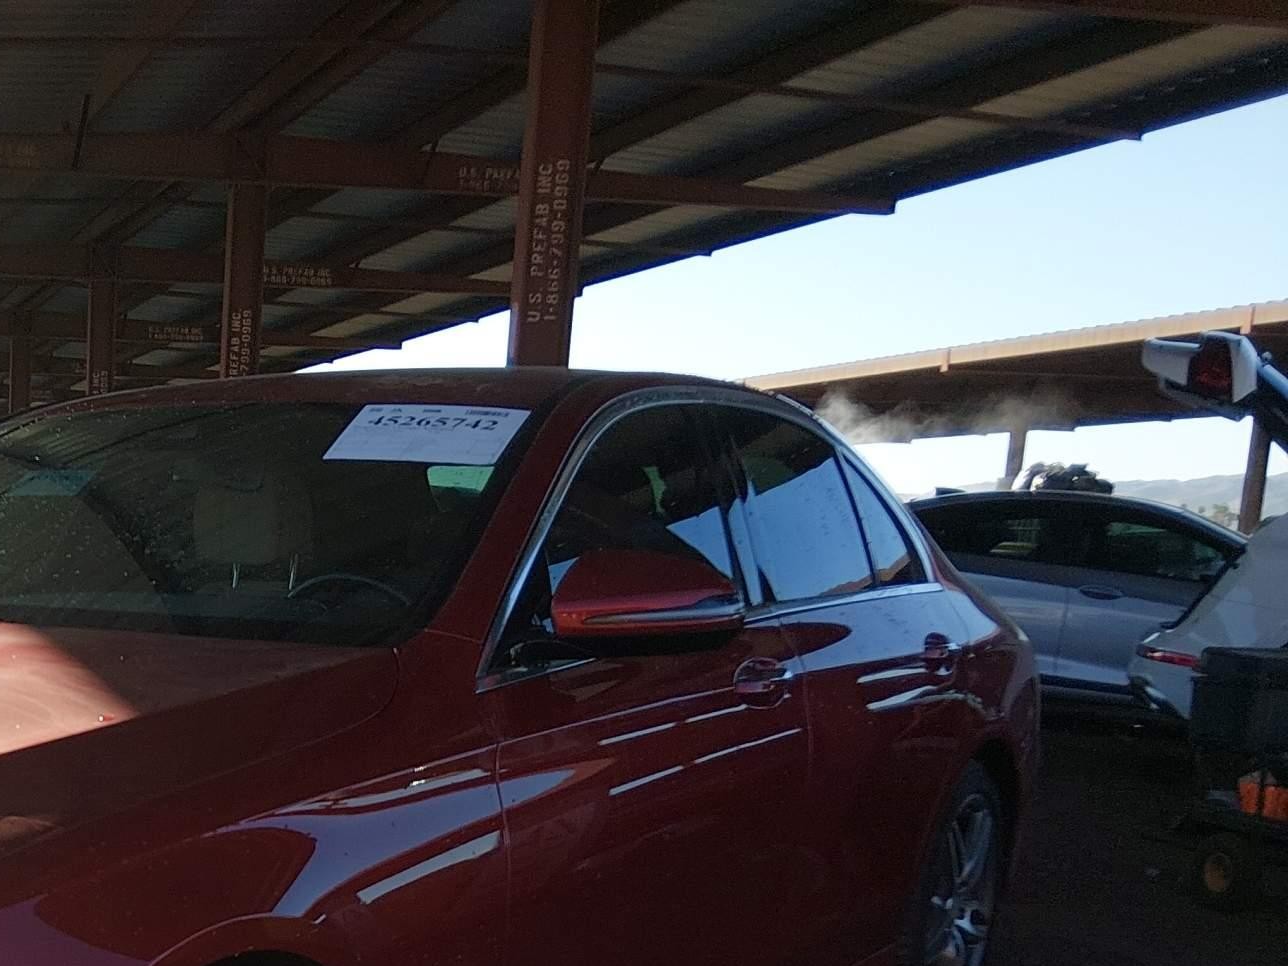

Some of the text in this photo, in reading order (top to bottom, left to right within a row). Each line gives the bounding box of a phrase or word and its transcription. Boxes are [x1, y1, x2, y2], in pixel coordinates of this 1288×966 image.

[537, 163, 553, 194] INC
[530, 203, 550, 276] PREFAB
[543, 158, 570, 320] 1-866-799-0969
[368, 414, 499, 431] 45265742
